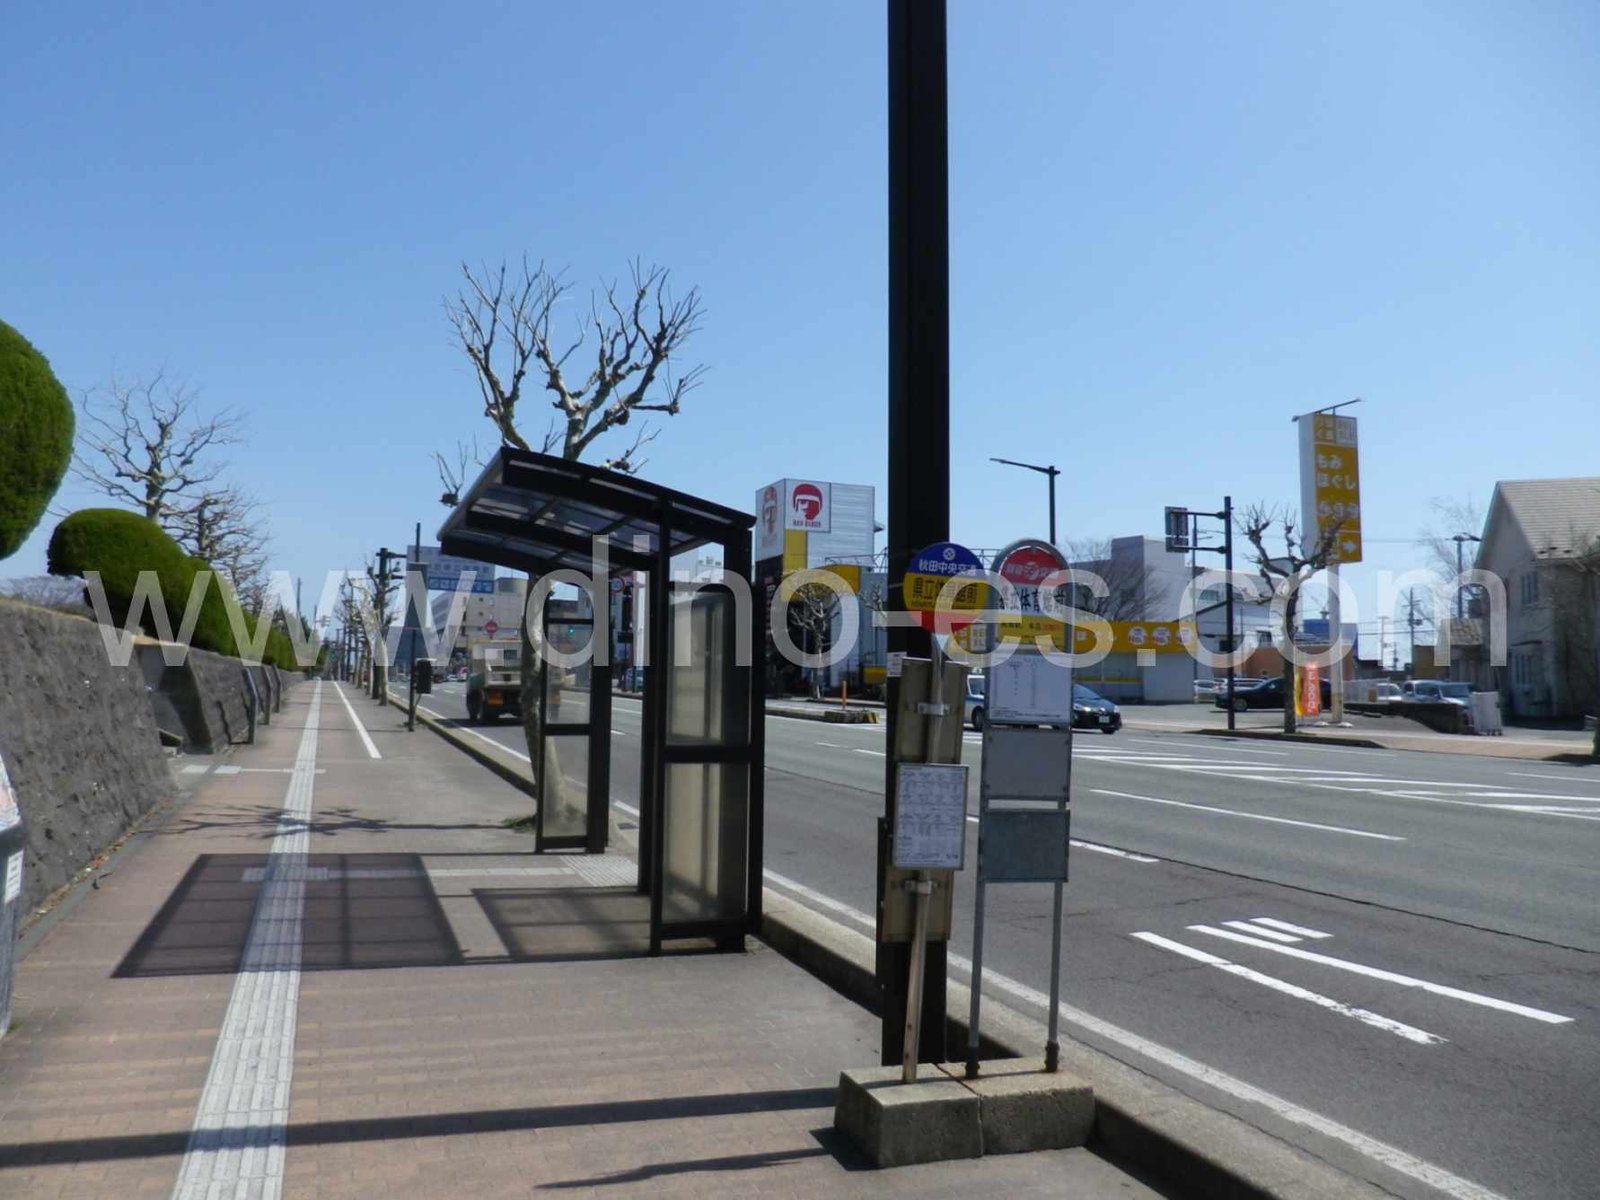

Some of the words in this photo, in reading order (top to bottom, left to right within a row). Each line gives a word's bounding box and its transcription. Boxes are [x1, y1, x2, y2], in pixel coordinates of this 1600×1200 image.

[1316, 474, 1356, 490] ほぐし
[918, 558, 977, 576] 秋田中央交通
